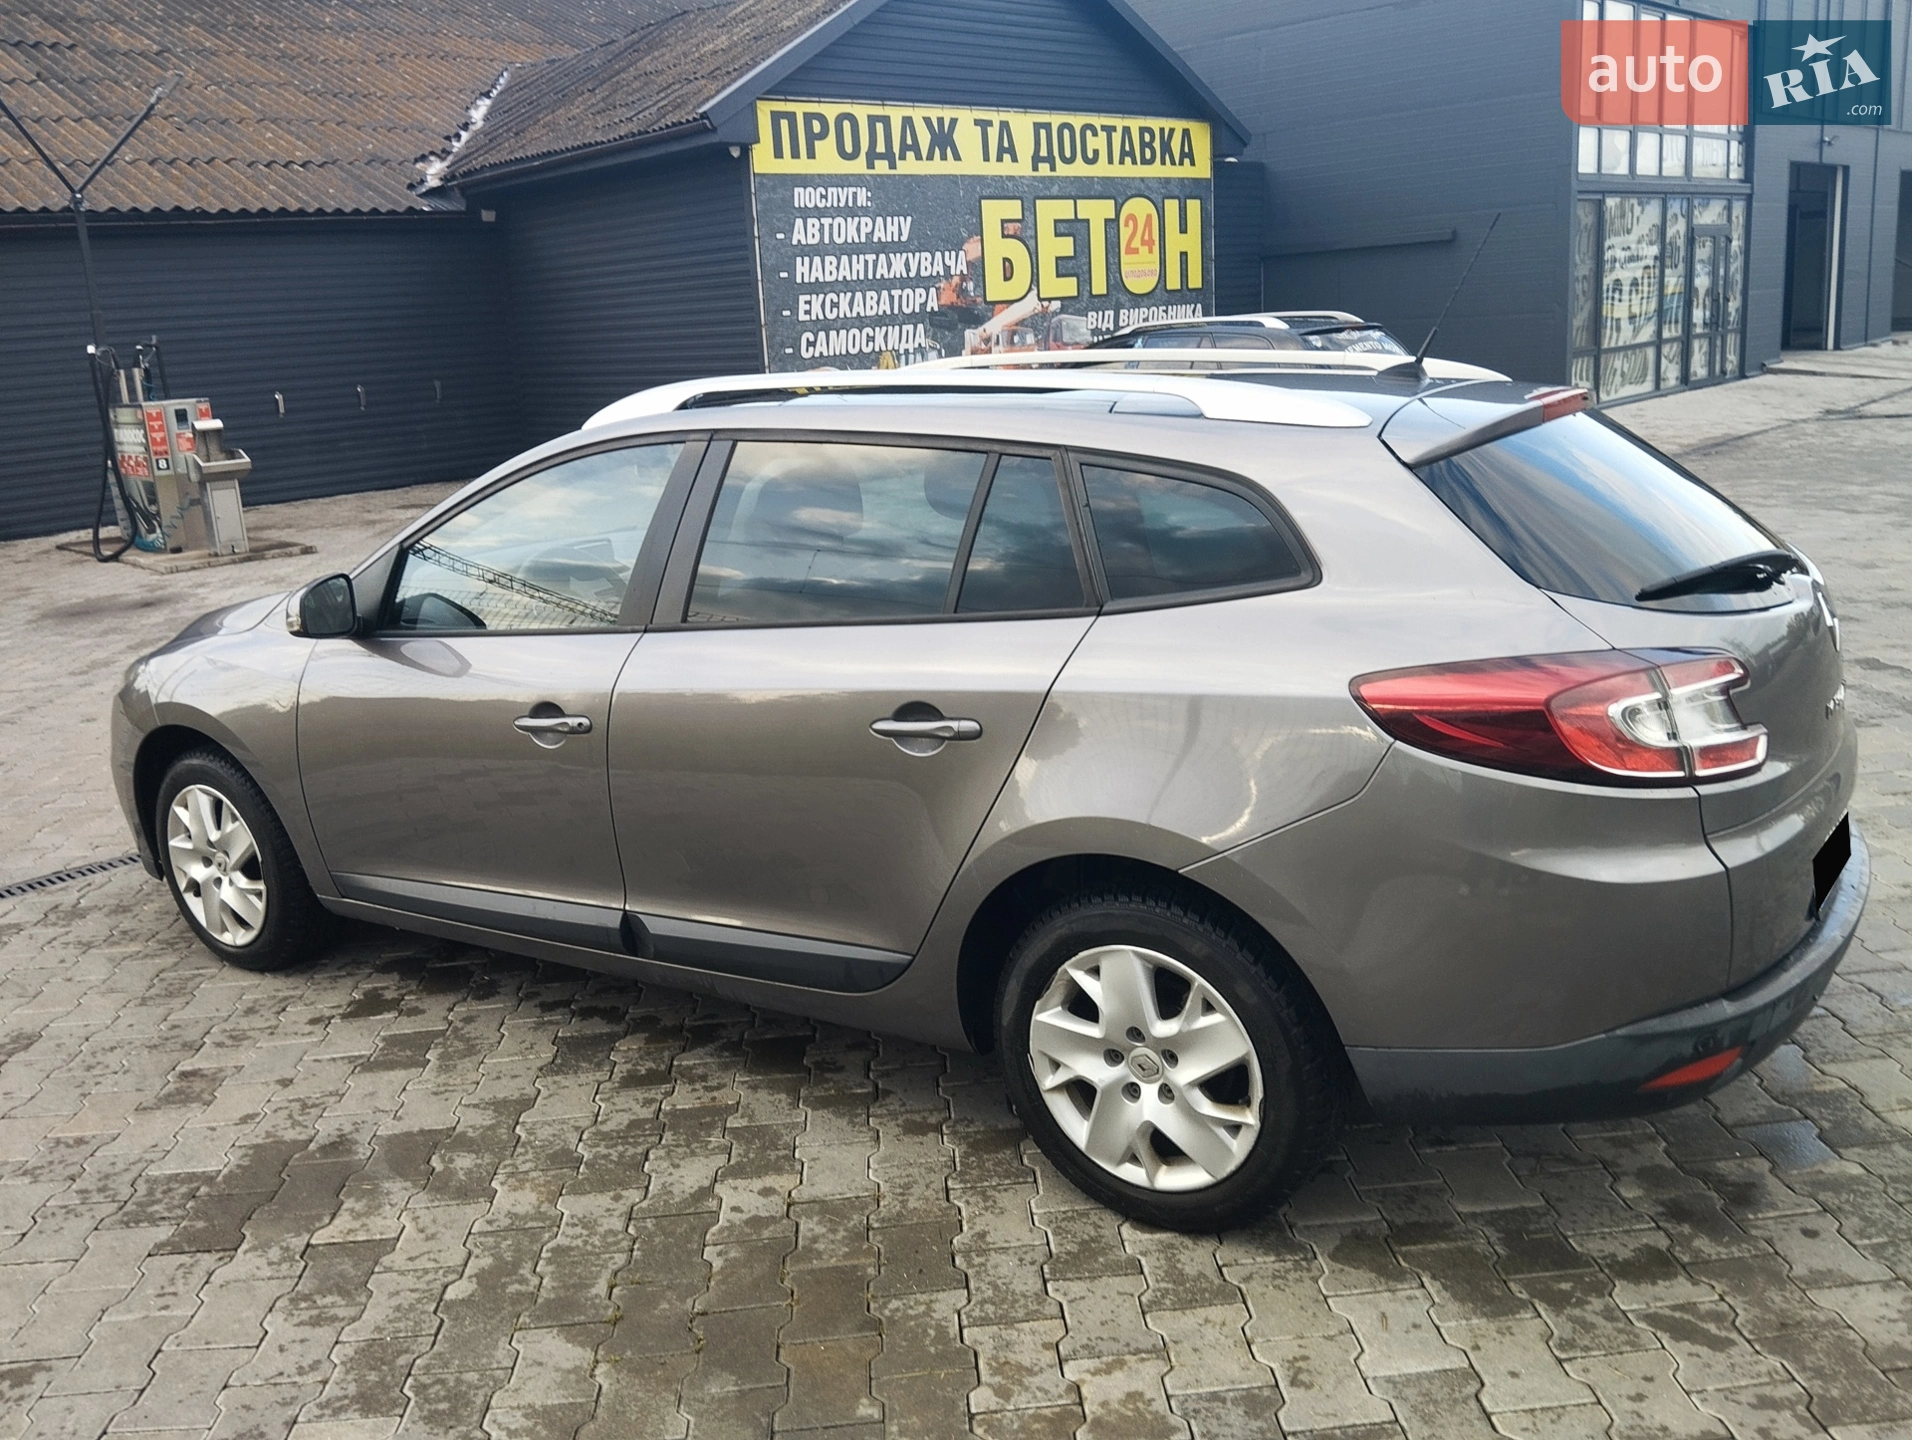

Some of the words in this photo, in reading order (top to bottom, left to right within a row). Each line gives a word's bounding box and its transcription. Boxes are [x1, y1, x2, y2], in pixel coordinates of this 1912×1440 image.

[770, 110, 963, 170] ПРОДАЖ
[974, 118, 1018, 163] ТА
[1032, 121, 1196, 172] ДОСТАВКА
[793, 186, 872, 208] ПОСЛУГИ:
[791, 215, 912, 245] АВТОКРАНУ
[1124, 213, 1155, 255] 24
[980, 196, 1202, 302] БЕТОН
[795, 250, 968, 284] НАВАНТАЖУВАЧА
[797, 286, 939, 322] ЕКСКАВАТОРА
[1086, 309, 1114, 332] ВІД
[1118, 303, 1203, 327] ВИРОБНИКА
[800, 323, 926, 359] САМОСКИДА
[158, 459, 168, 470] 8
